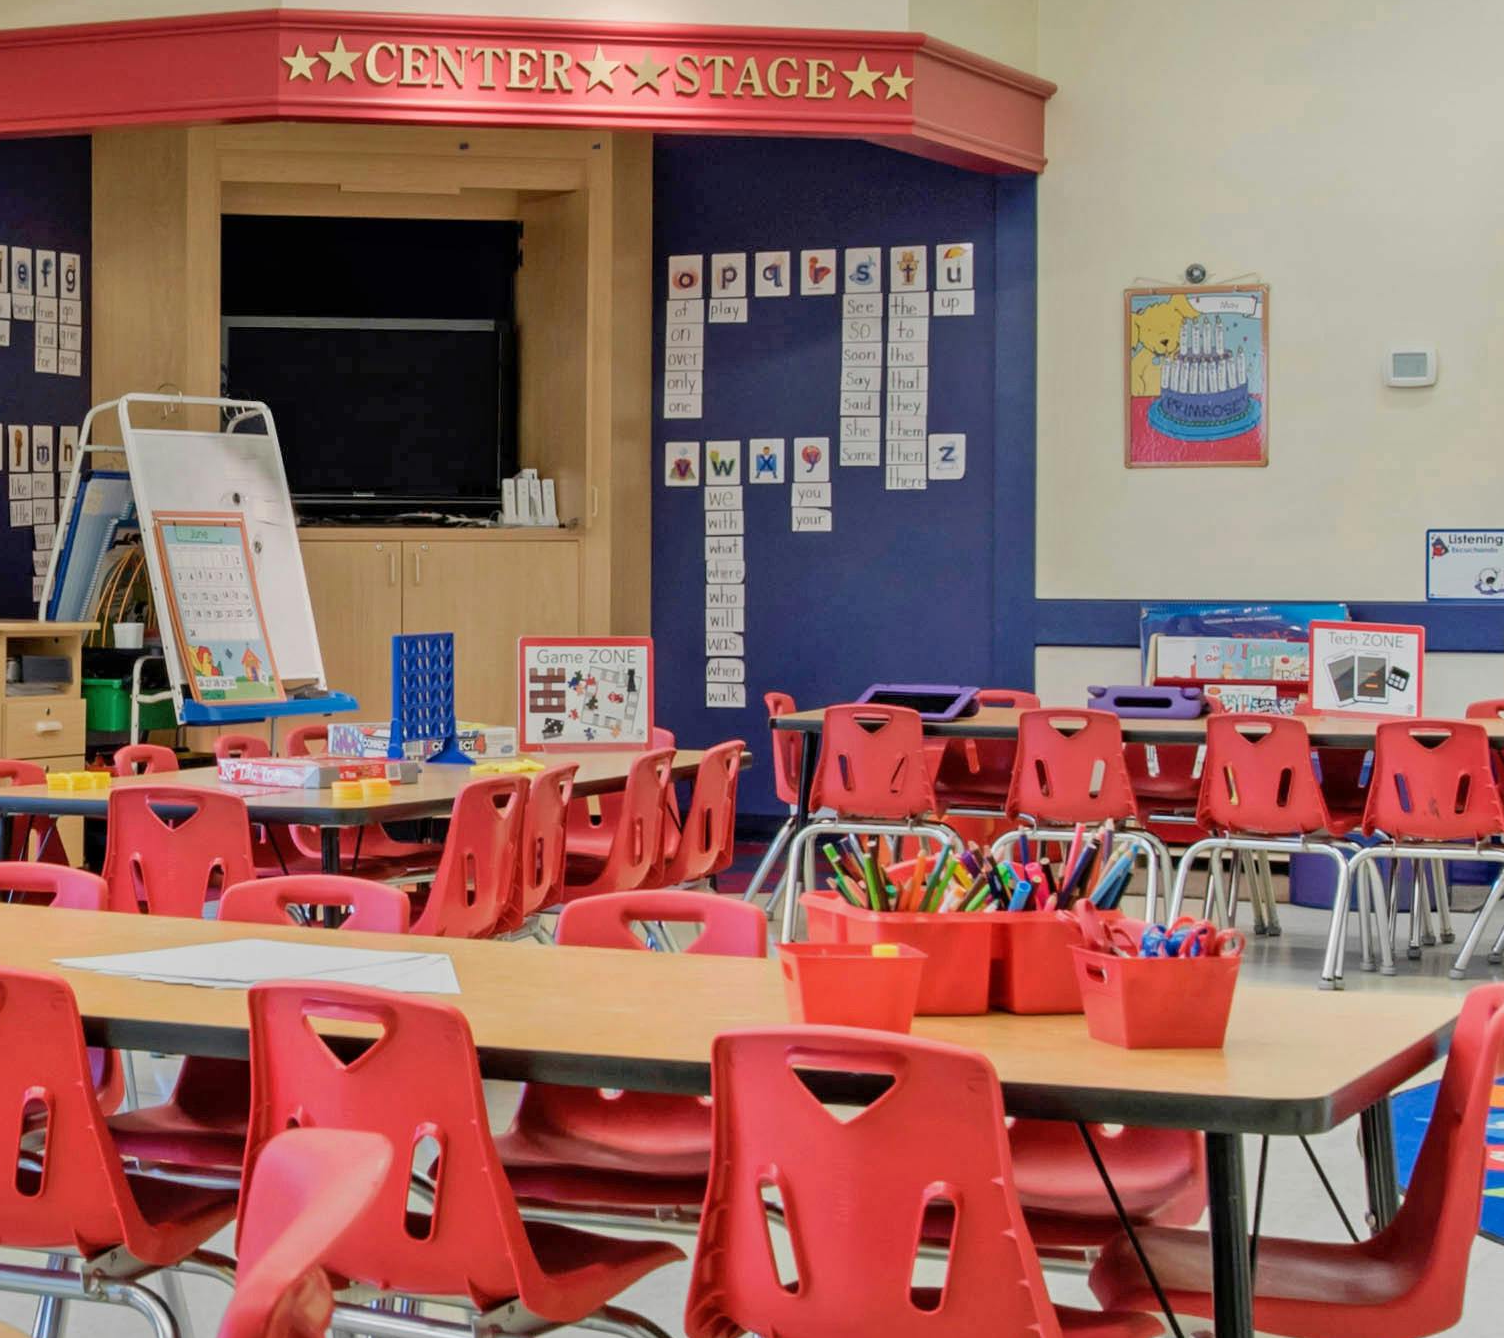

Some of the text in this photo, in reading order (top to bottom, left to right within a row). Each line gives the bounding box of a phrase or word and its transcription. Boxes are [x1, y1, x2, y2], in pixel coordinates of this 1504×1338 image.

[364, 41, 838, 100] CENTER STAGE
[679, 272, 694, 289] o
[721, 266, 738, 291] p
[946, 265, 962, 283] u
[674, 301, 690, 318] of
[710, 301, 740, 321] play
[891, 296, 917, 315] the
[941, 295, 960, 312] up
[671, 326, 691, 342] on
[896, 320, 915, 338] to
[668, 352, 699, 367] over
[890, 345, 914, 362] this
[667, 373, 697, 395] only
[891, 369, 920, 390] that
[669, 401, 692, 413] one
[890, 394, 921, 417] they
[1166, 397, 1243, 420] PRIMROSE
[890, 419, 924, 438] them
[890, 443, 923, 462] then
[709, 490, 734, 508] we
[798, 487, 821, 506] you
[708, 513, 738, 530] with
[795, 514, 825, 531] your
[709, 538, 738, 555] what
[1448, 534, 1504, 547] Listening
[709, 586, 737, 604] who
[710, 609, 736, 627] will
[708, 635, 737, 651] was
[1328, 631, 1404, 649] Tech ZONE
[537, 648, 637, 665] Game ZONE
[707, 660, 741, 678] when
[708, 684, 739, 703] walk
